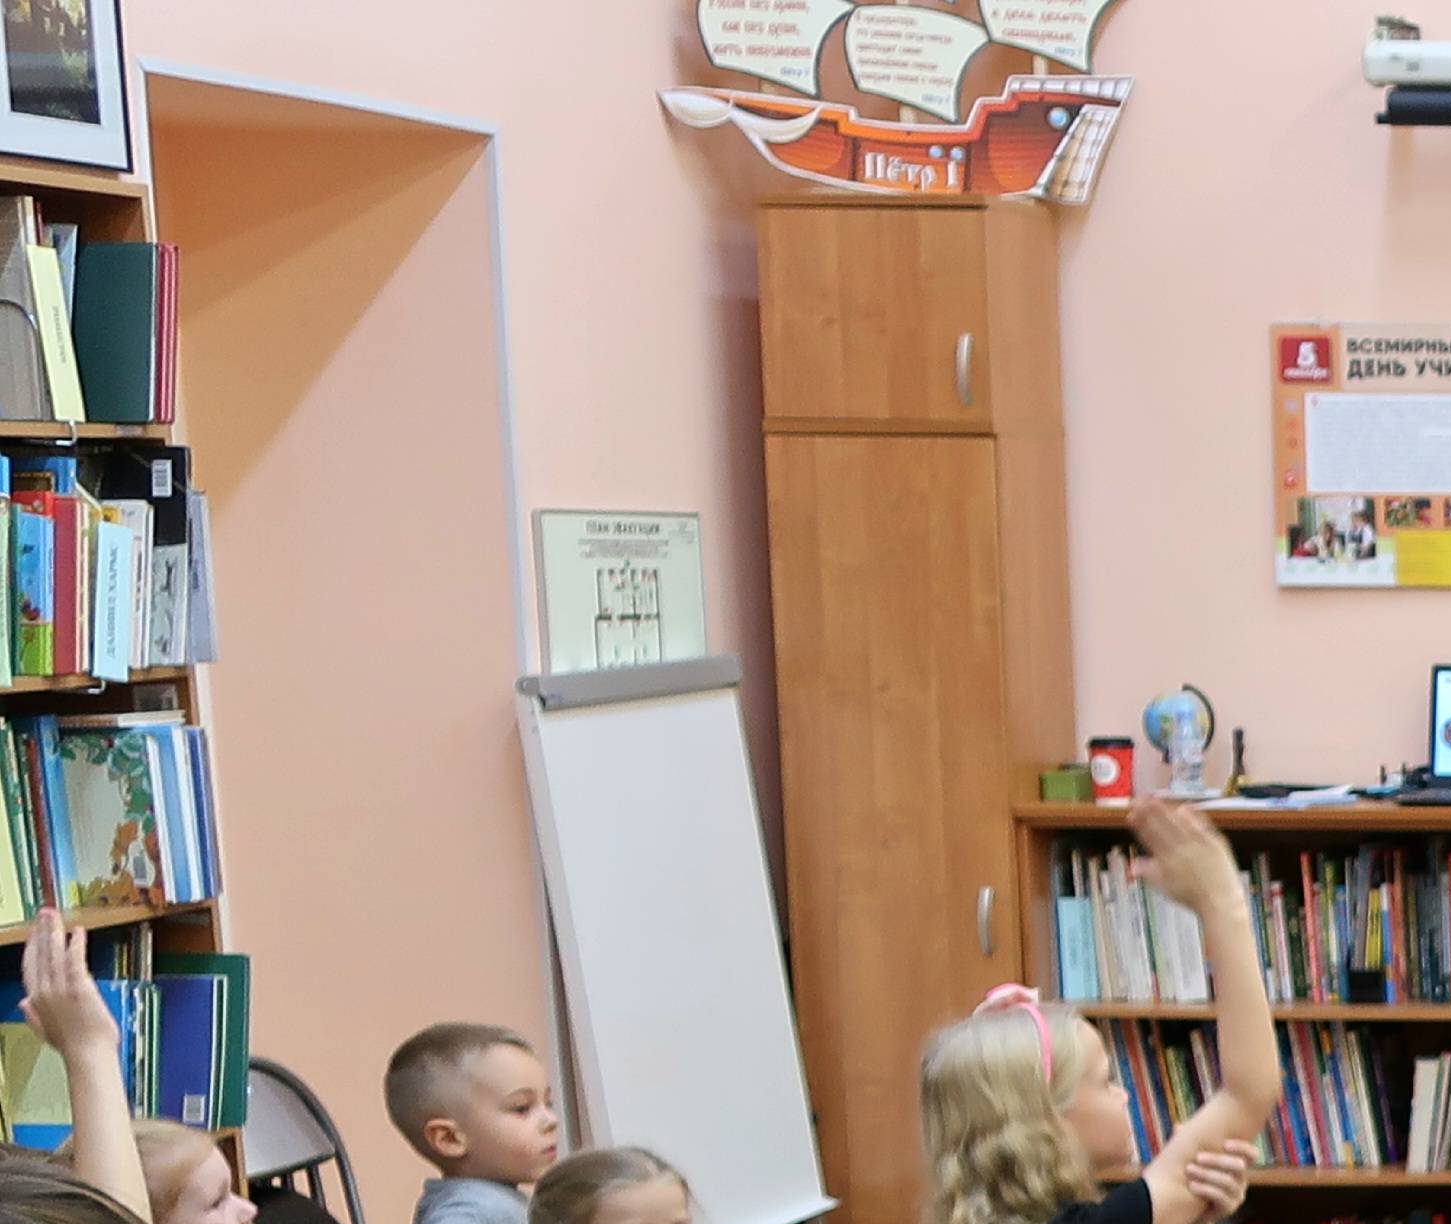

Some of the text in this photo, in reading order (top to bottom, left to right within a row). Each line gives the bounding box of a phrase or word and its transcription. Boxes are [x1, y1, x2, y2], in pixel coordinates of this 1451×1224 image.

[864, 151, 938, 192] Пётр
[1297, 341, 1319, 368] 5
[1346, 358, 1407, 380] ДЕНЬ
